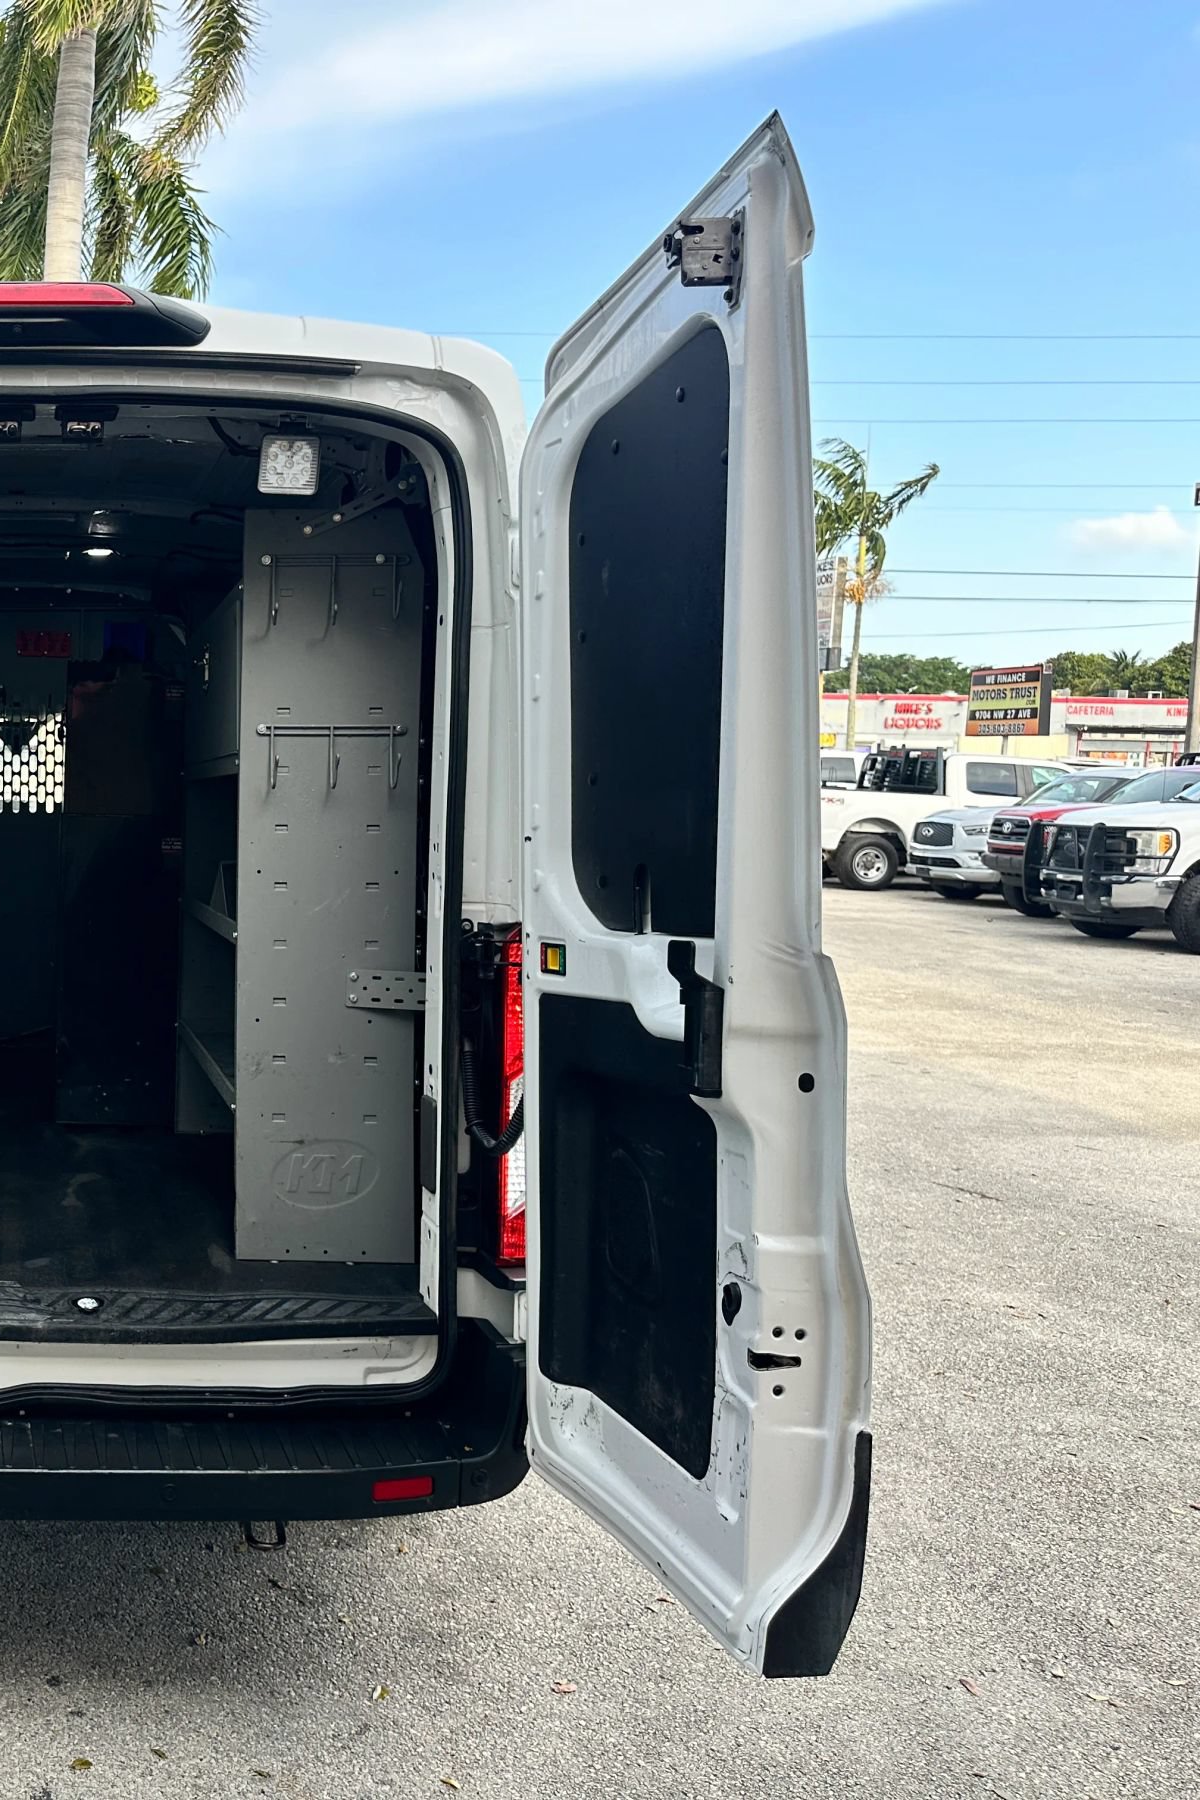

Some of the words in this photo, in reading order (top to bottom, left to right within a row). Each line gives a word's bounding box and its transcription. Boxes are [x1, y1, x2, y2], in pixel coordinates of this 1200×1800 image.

[817, 560, 834, 572] KE'S
[985, 674, 995, 684] WE
[997, 672, 1026, 683] FINANCE
[972, 688, 1007, 701] MOTORS
[1010, 686, 1038, 699] TRUST
[975, 710, 991, 719] 9704
[993, 710, 1005, 719] NW
[1006, 709, 1015, 719] 27
[1017, 709, 1031, 718] AVE
[1066, 705, 1115, 716] CAFETERIA
[884, 716, 943, 730] LIQUORS
